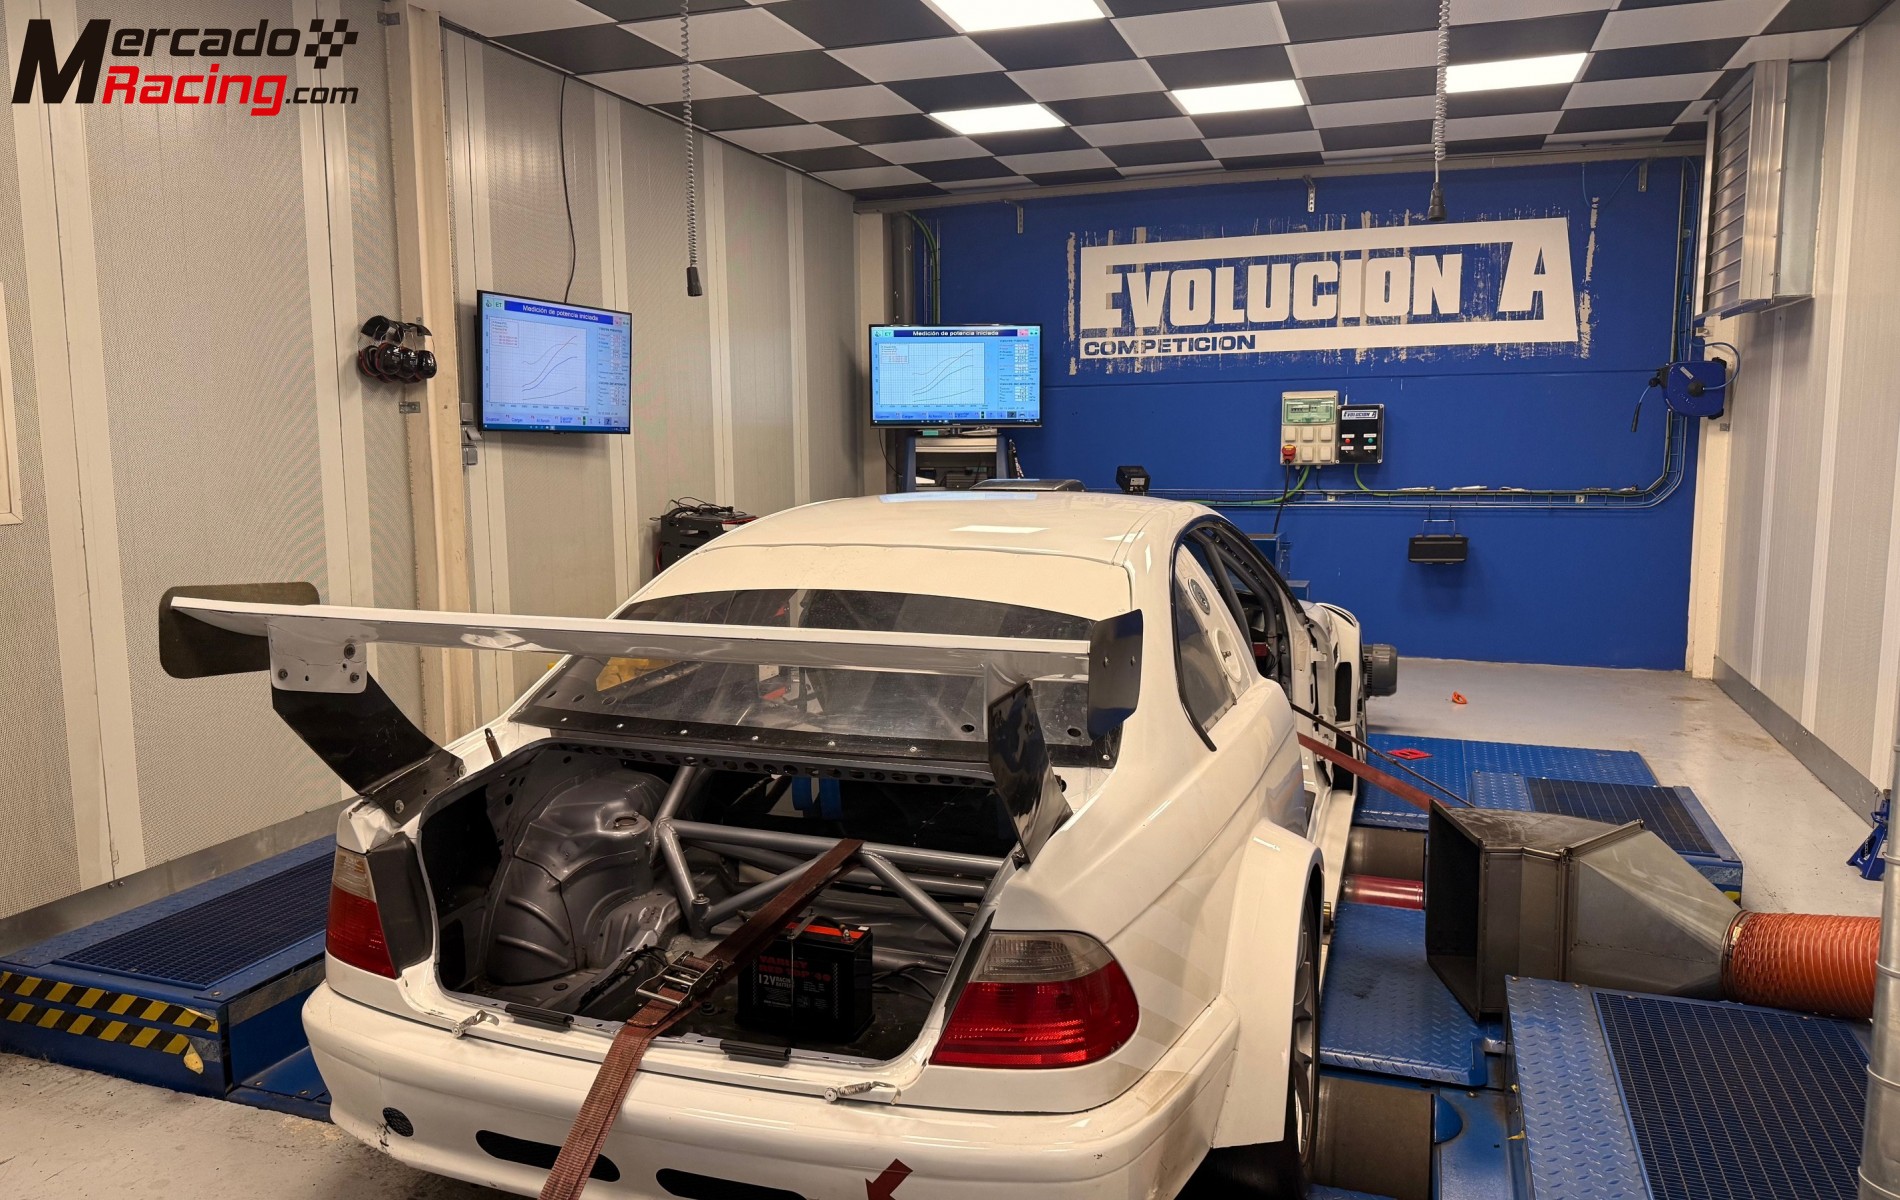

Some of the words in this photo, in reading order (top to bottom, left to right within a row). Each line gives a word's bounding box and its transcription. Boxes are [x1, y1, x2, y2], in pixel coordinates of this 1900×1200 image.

[1081, 247, 1462, 328] EVOLUCION
[1498, 220, 1577, 335] A
[522, 304, 548, 315] Medición
[556, 310, 579, 319] potencia
[579, 313, 599, 321] iniciada
[912, 329, 940, 337] Medición
[1084, 335, 1256, 356] COMPETICION
[759, 974, 775, 985] 12V
